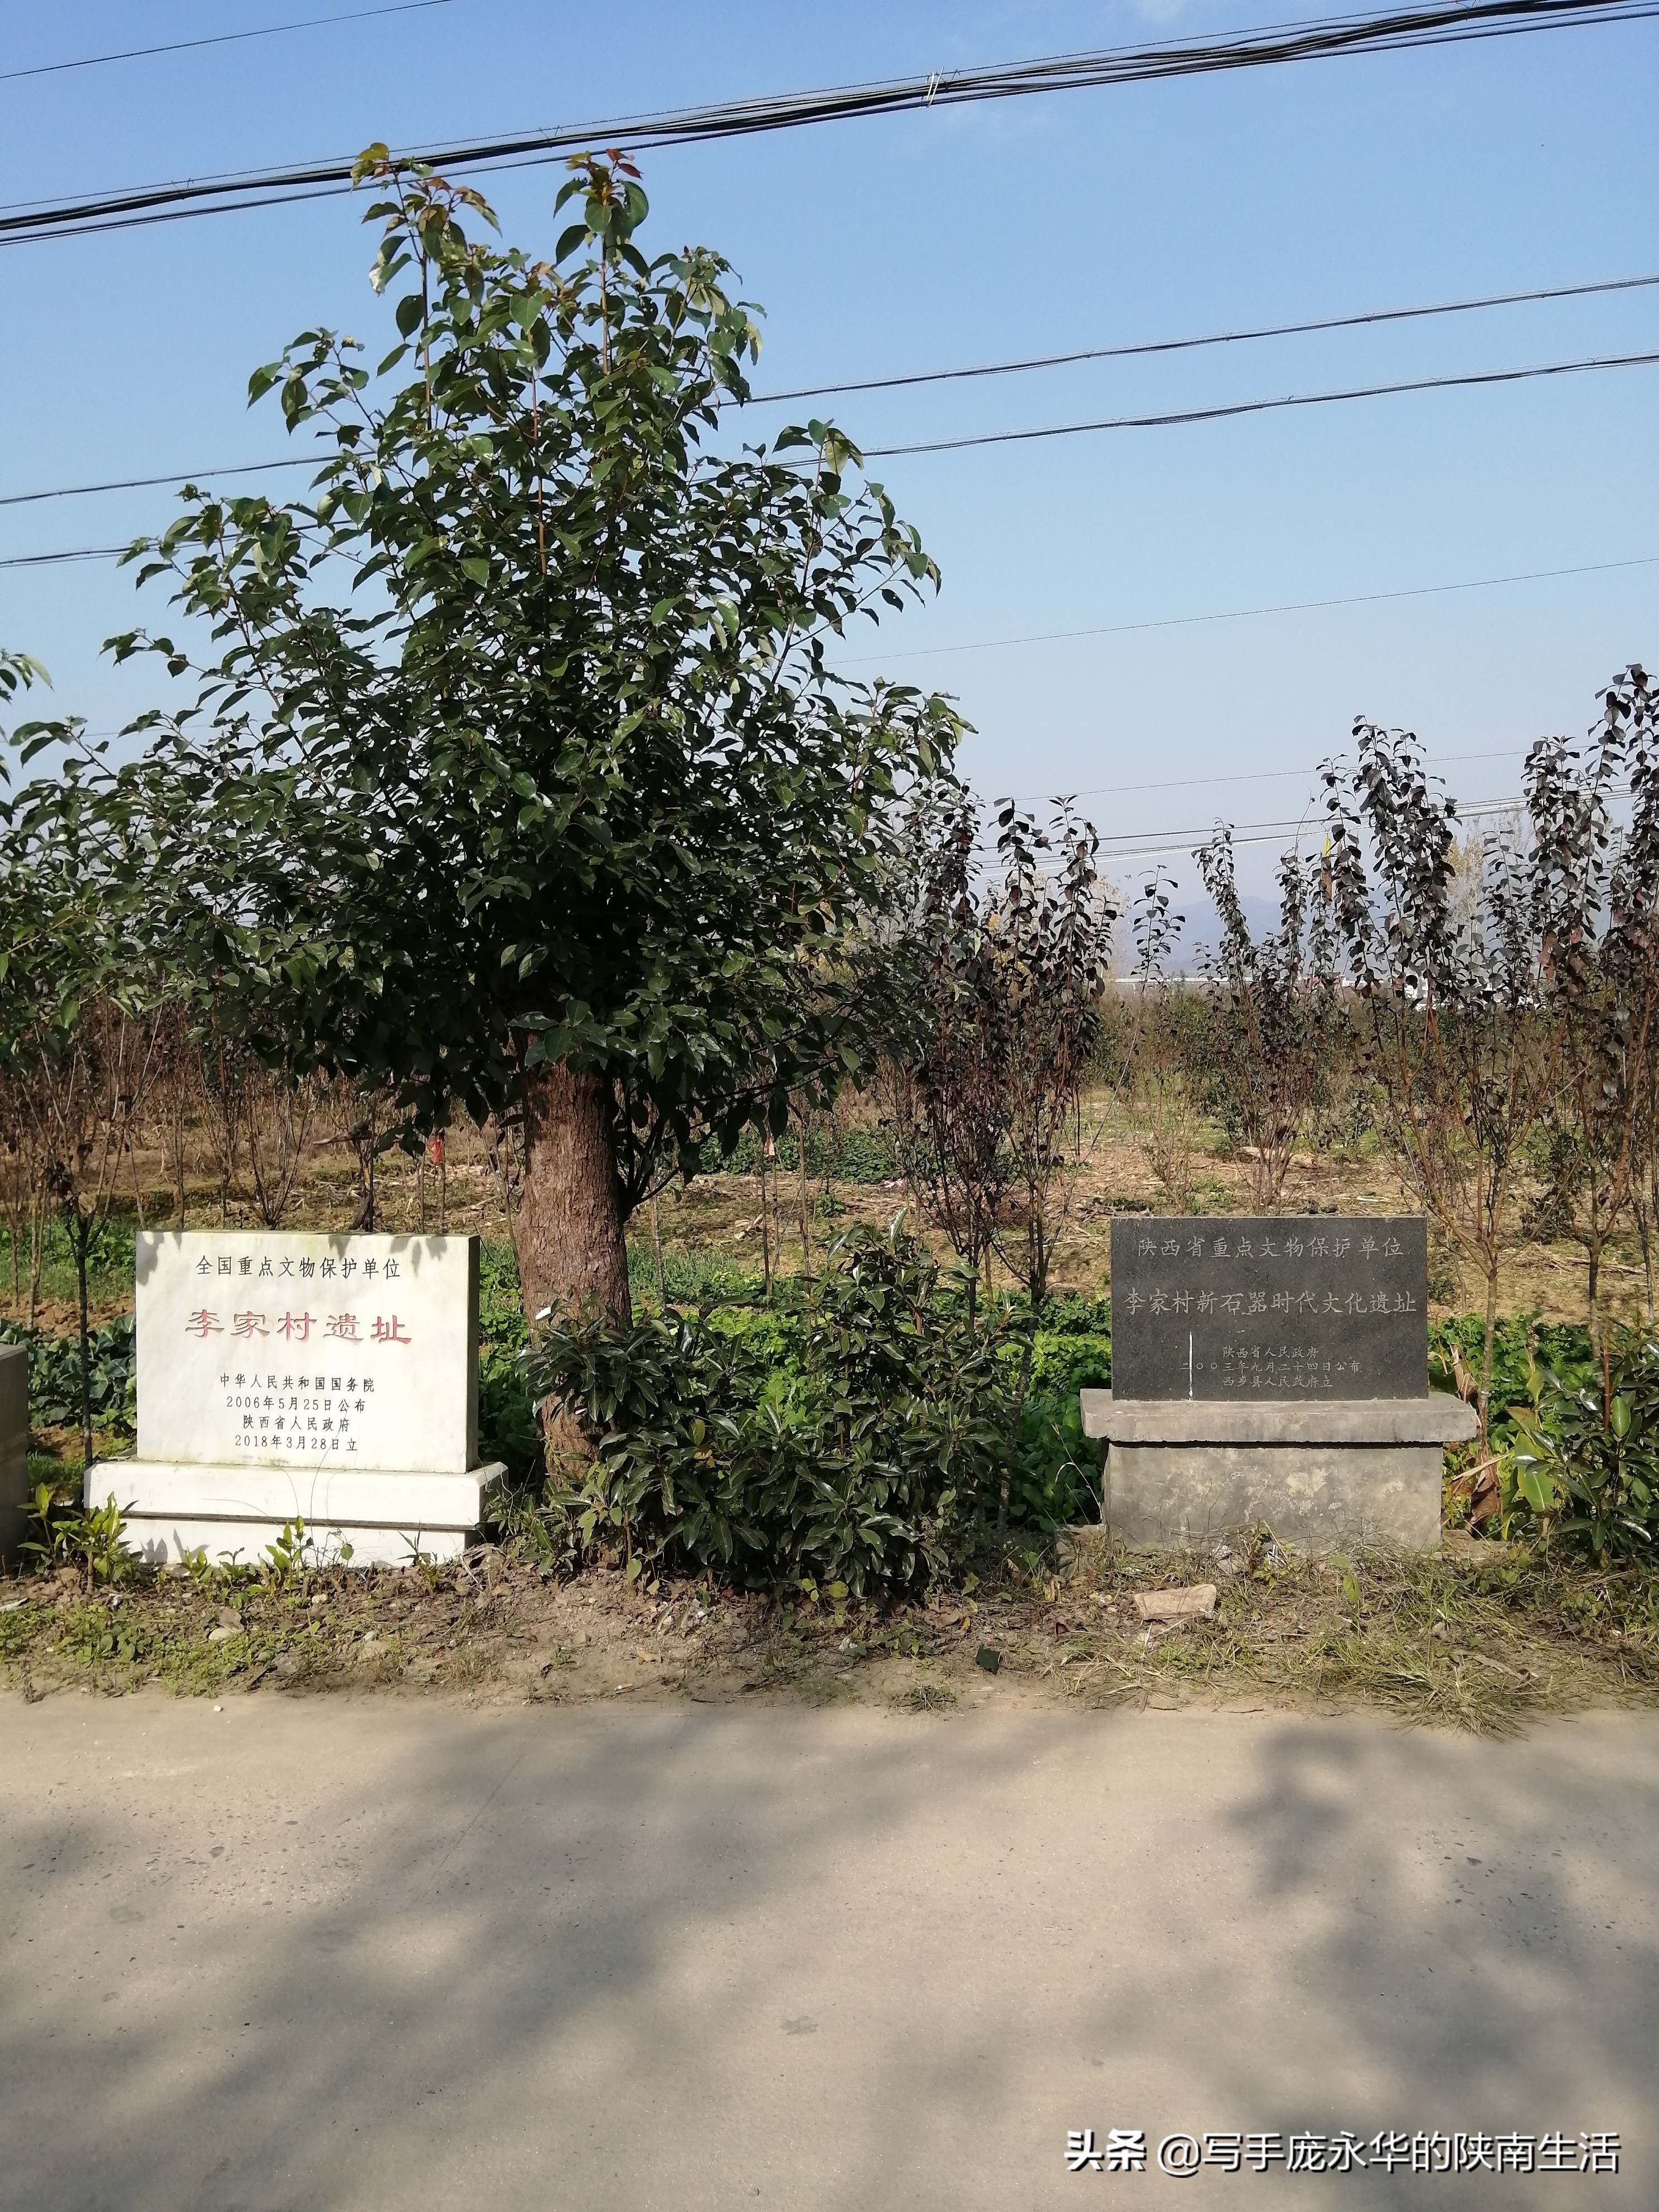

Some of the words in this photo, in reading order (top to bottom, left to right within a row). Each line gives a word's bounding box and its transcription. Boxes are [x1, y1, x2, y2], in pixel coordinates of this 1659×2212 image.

[1137, 1235, 1404, 1260] 陕西省重点文物保护单位
[195, 1255, 401, 1279] 全国重点文物保护单位
[1122, 1287, 1417, 1316] 李家村新石器时代文化遗址
[185, 1309, 412, 1345] 李家村遗址
[1223, 1345, 1319, 1359] 陕西省人民政府
[220, 1373, 375, 1393] 中华人民共和国国务院
[1222, 1375, 1333, 1388] 西乡县人民政府立
[226, 1395, 366, 1413] 2006年5月25日公布
[243, 1414, 351, 1432] 陕西省人民政府
[235, 1434, 357, 1451] 2018年3月28日立
